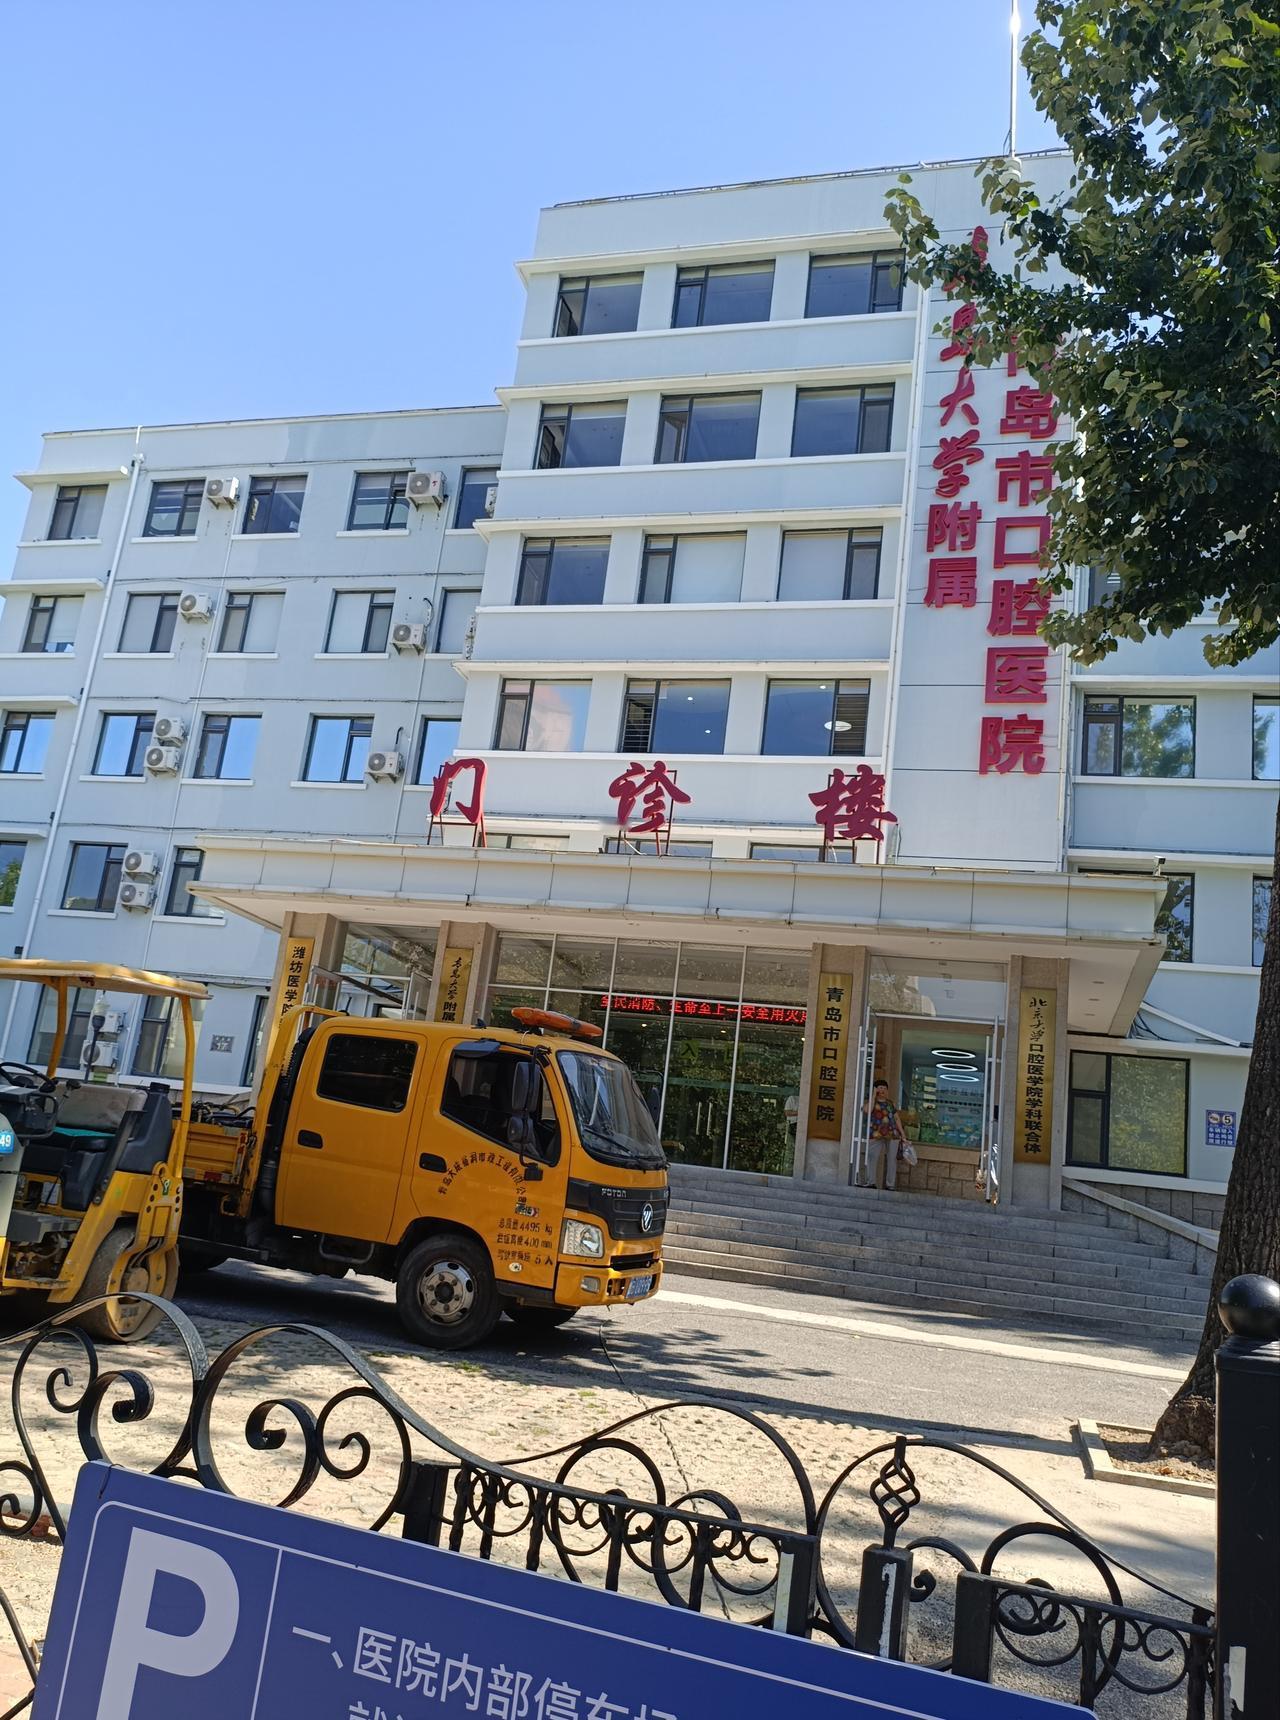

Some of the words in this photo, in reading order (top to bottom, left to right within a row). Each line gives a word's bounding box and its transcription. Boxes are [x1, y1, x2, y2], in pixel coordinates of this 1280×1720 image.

[924, 226, 988, 608] 岛大学附属
[978, 336, 1057, 775] 岛市口腔医院
[430, 757, 897, 842] 门诊楼
[816, 986, 844, 1122] 青岛市口腔医院
[1024, 997, 1047, 1153] 北京大学口腔医学院学科联合体
[601, 1187, 627, 1198] FOTON
[98, 1526, 240, 1720] P
